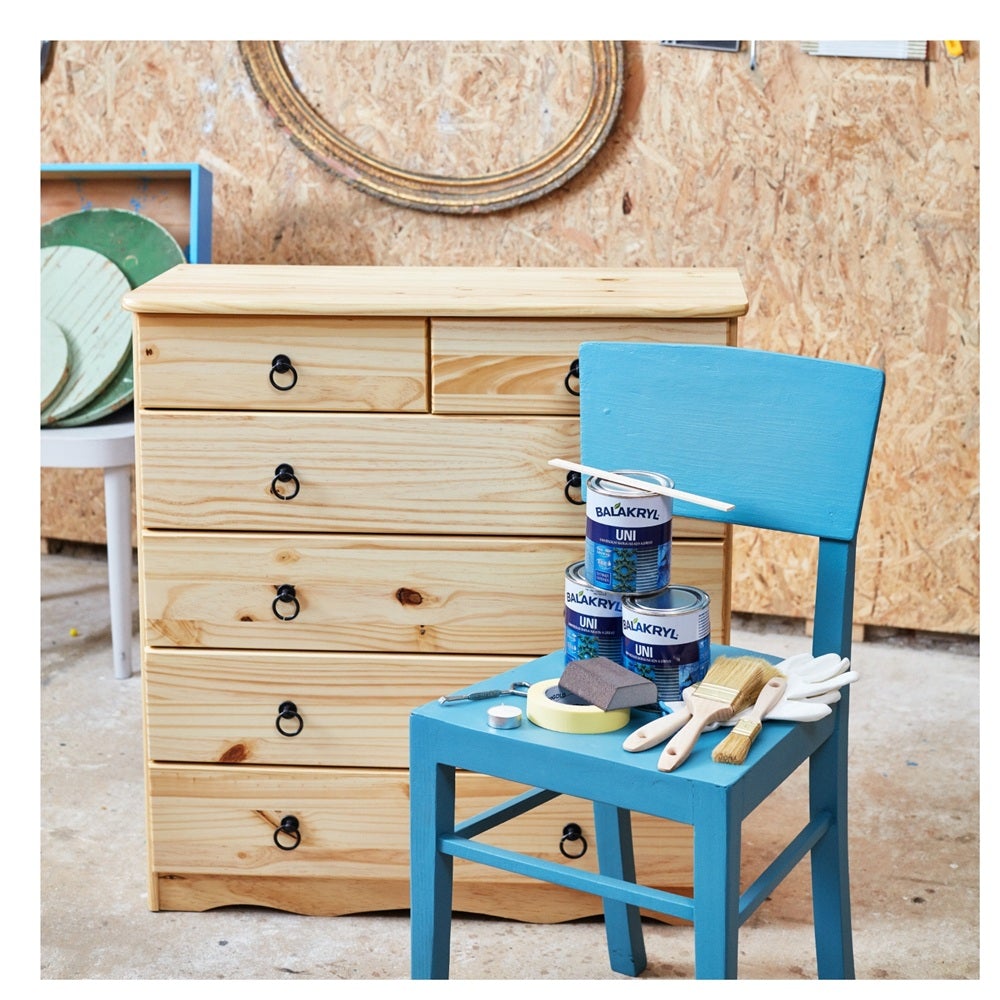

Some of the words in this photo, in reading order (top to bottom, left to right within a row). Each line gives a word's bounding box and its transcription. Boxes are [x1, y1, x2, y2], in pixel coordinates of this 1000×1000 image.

[595, 506, 660, 521] BALAKRYL
[615, 528, 637, 541] UNI
[566, 591, 623, 612] BALAKRYL
[579, 615, 598, 630] UNI
[622, 619, 679, 640] BALAKRYL
[635, 643, 653, 658] UNI
